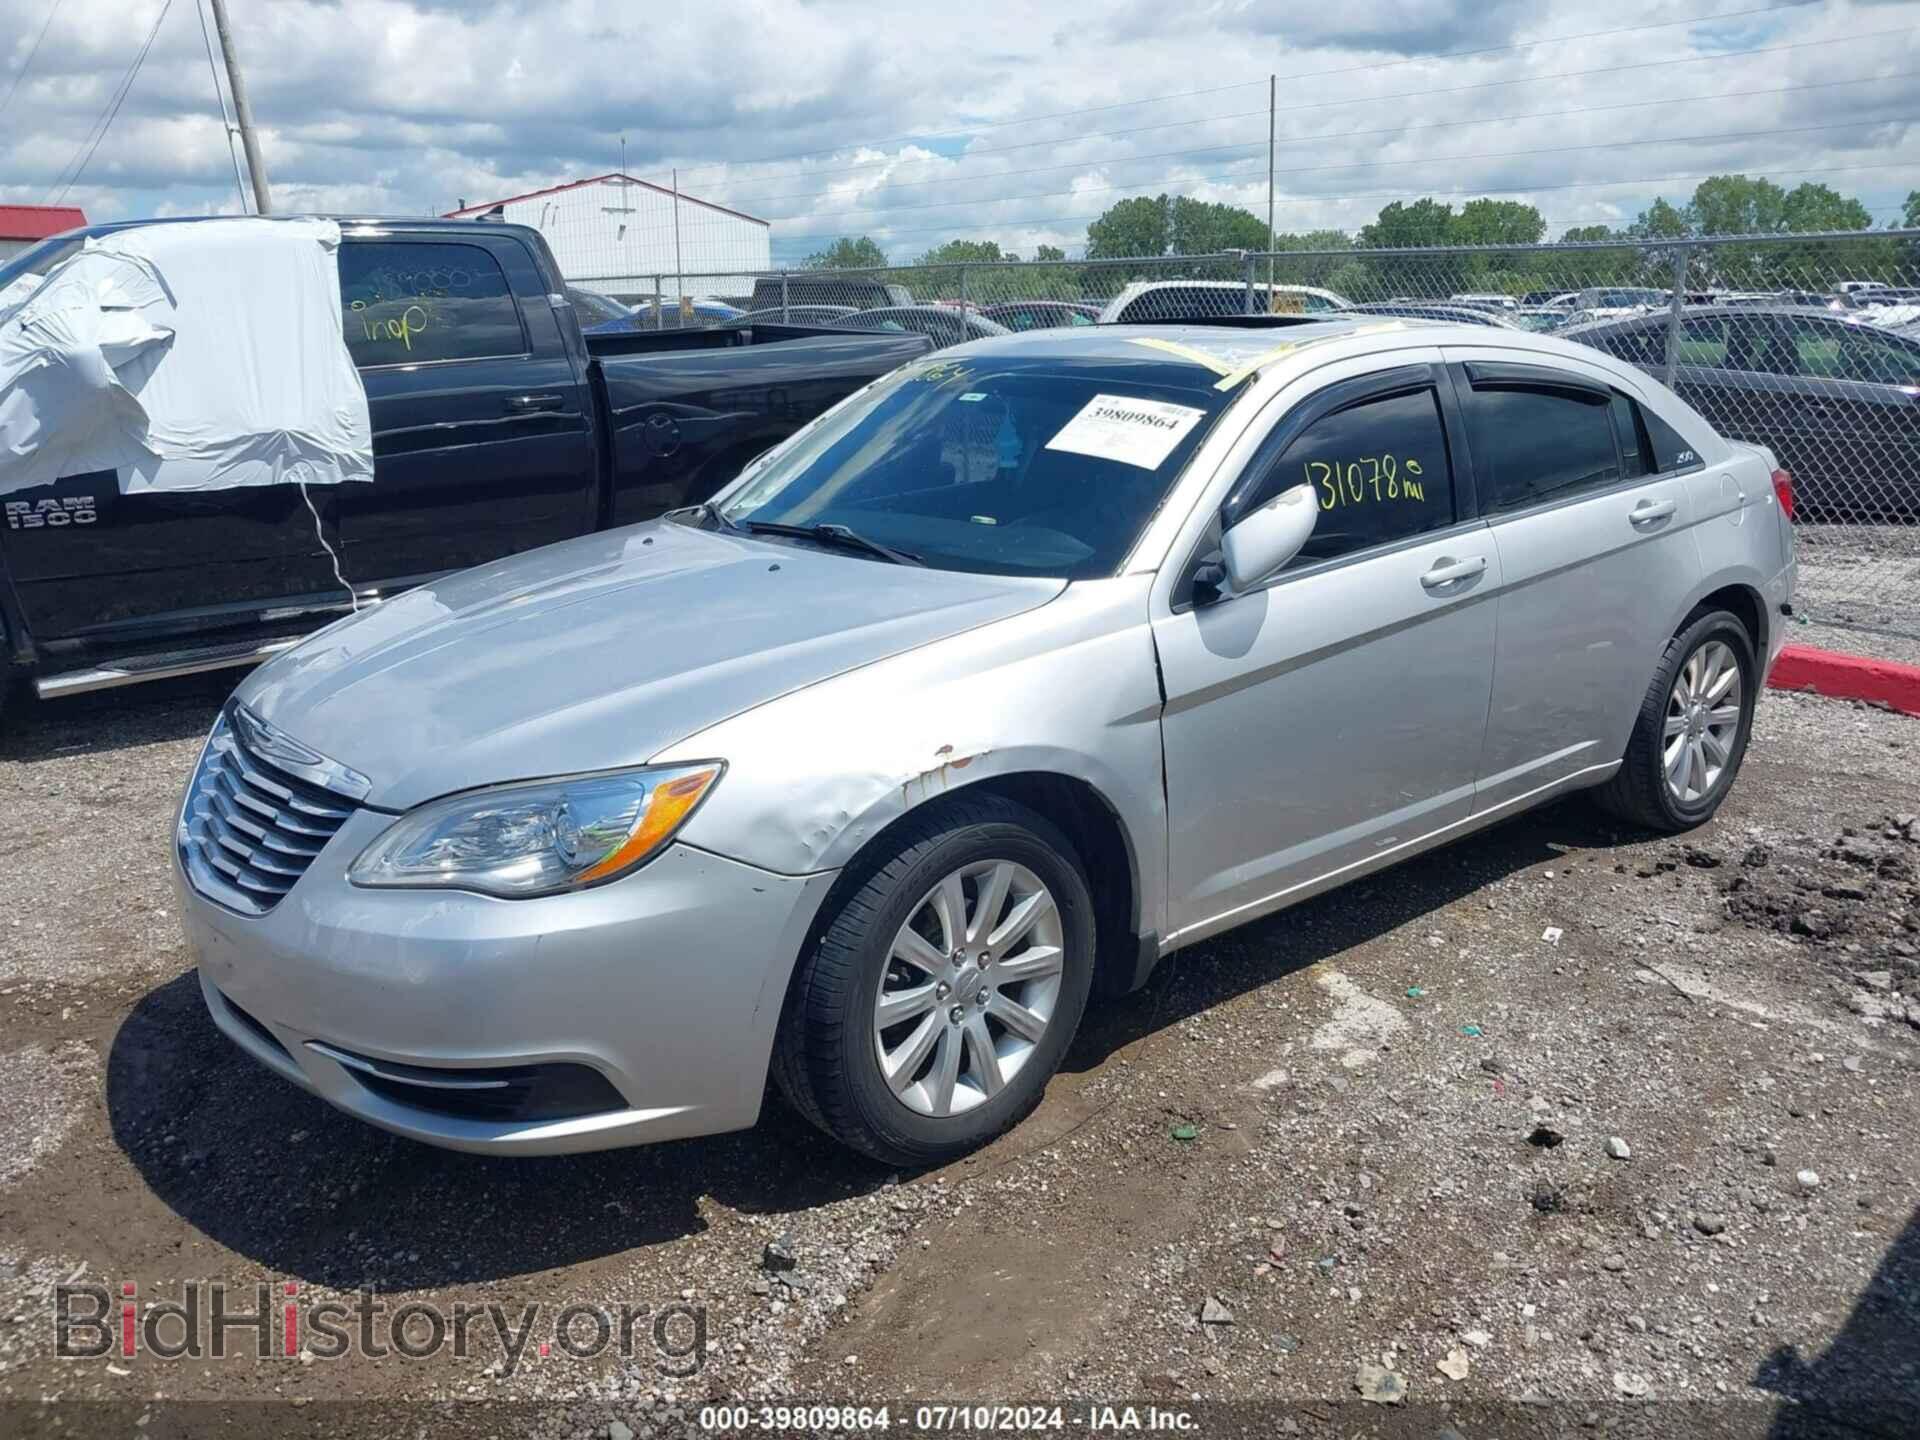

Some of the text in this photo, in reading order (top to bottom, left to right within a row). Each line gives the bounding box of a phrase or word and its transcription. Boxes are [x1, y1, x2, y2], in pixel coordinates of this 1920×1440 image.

[1088, 406, 1179, 431] 39809864
[5, 496, 95, 515] RAM
[7, 510, 97, 529] 1500
